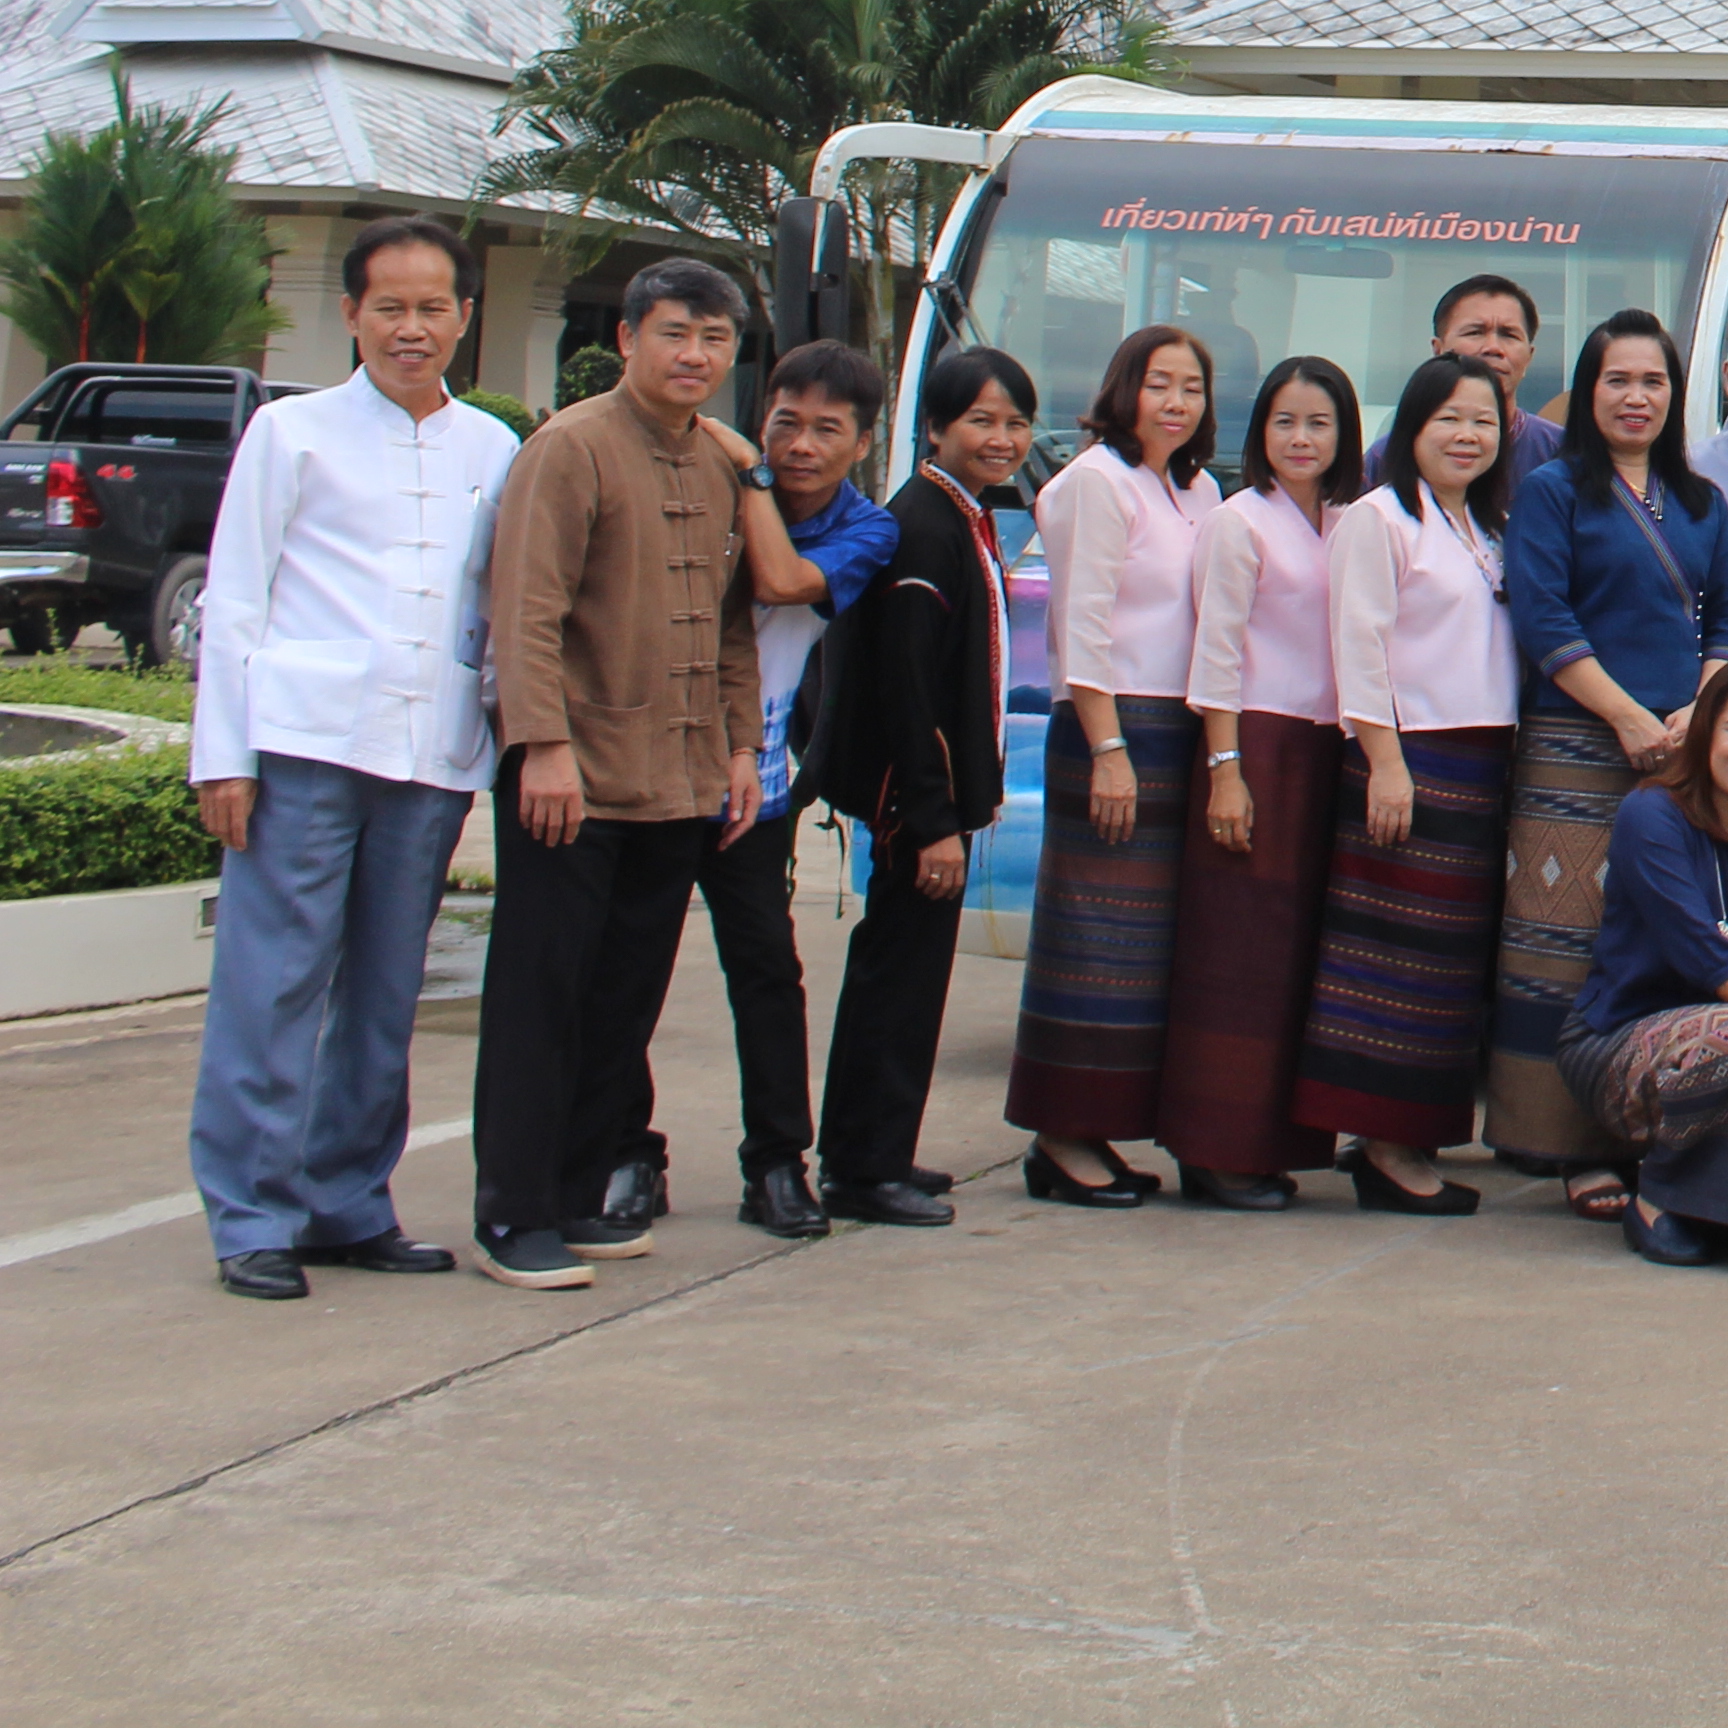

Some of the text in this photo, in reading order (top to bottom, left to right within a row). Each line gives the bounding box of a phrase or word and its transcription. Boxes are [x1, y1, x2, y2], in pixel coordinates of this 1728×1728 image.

[1100, 196, 1581, 244] เที่ยวเท่ห์ๆ กับเสน่ห์เมืองน่าน
